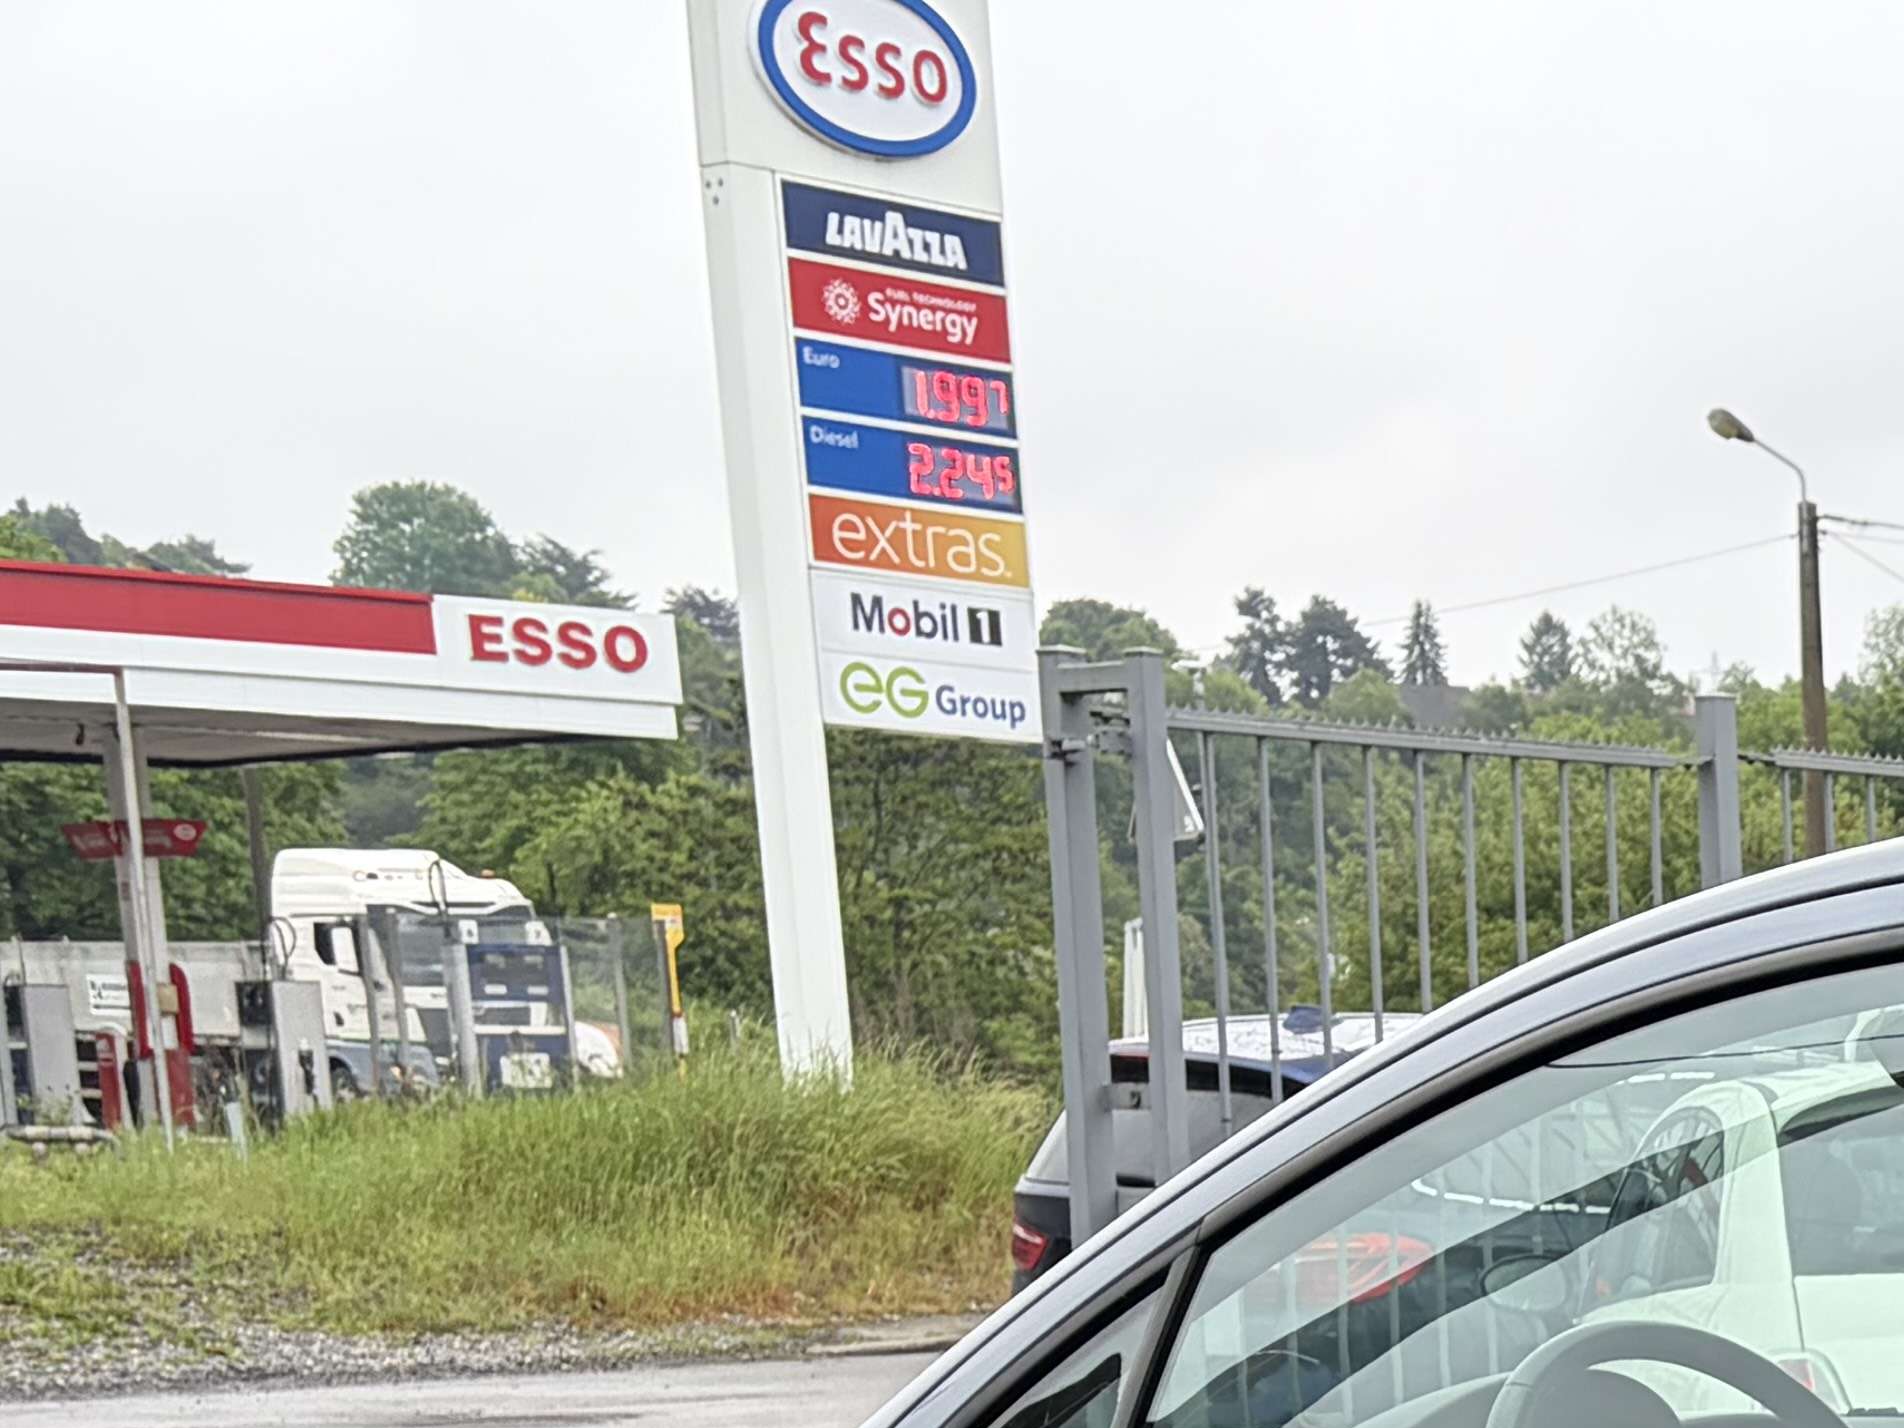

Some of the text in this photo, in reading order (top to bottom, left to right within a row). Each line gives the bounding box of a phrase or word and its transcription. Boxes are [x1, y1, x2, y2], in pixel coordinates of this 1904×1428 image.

[867, 291, 979, 346] Synergy
[803, 346, 840, 369] Euro
[914, 370, 1009, 428] 1.997
[809, 425, 860, 449] Diesel
[907, 442, 1016, 499] 2.245
[850, 592, 960, 642] Mobil
[467, 613, 650, 674] ESSO
[935, 685, 1027, 728] Group
